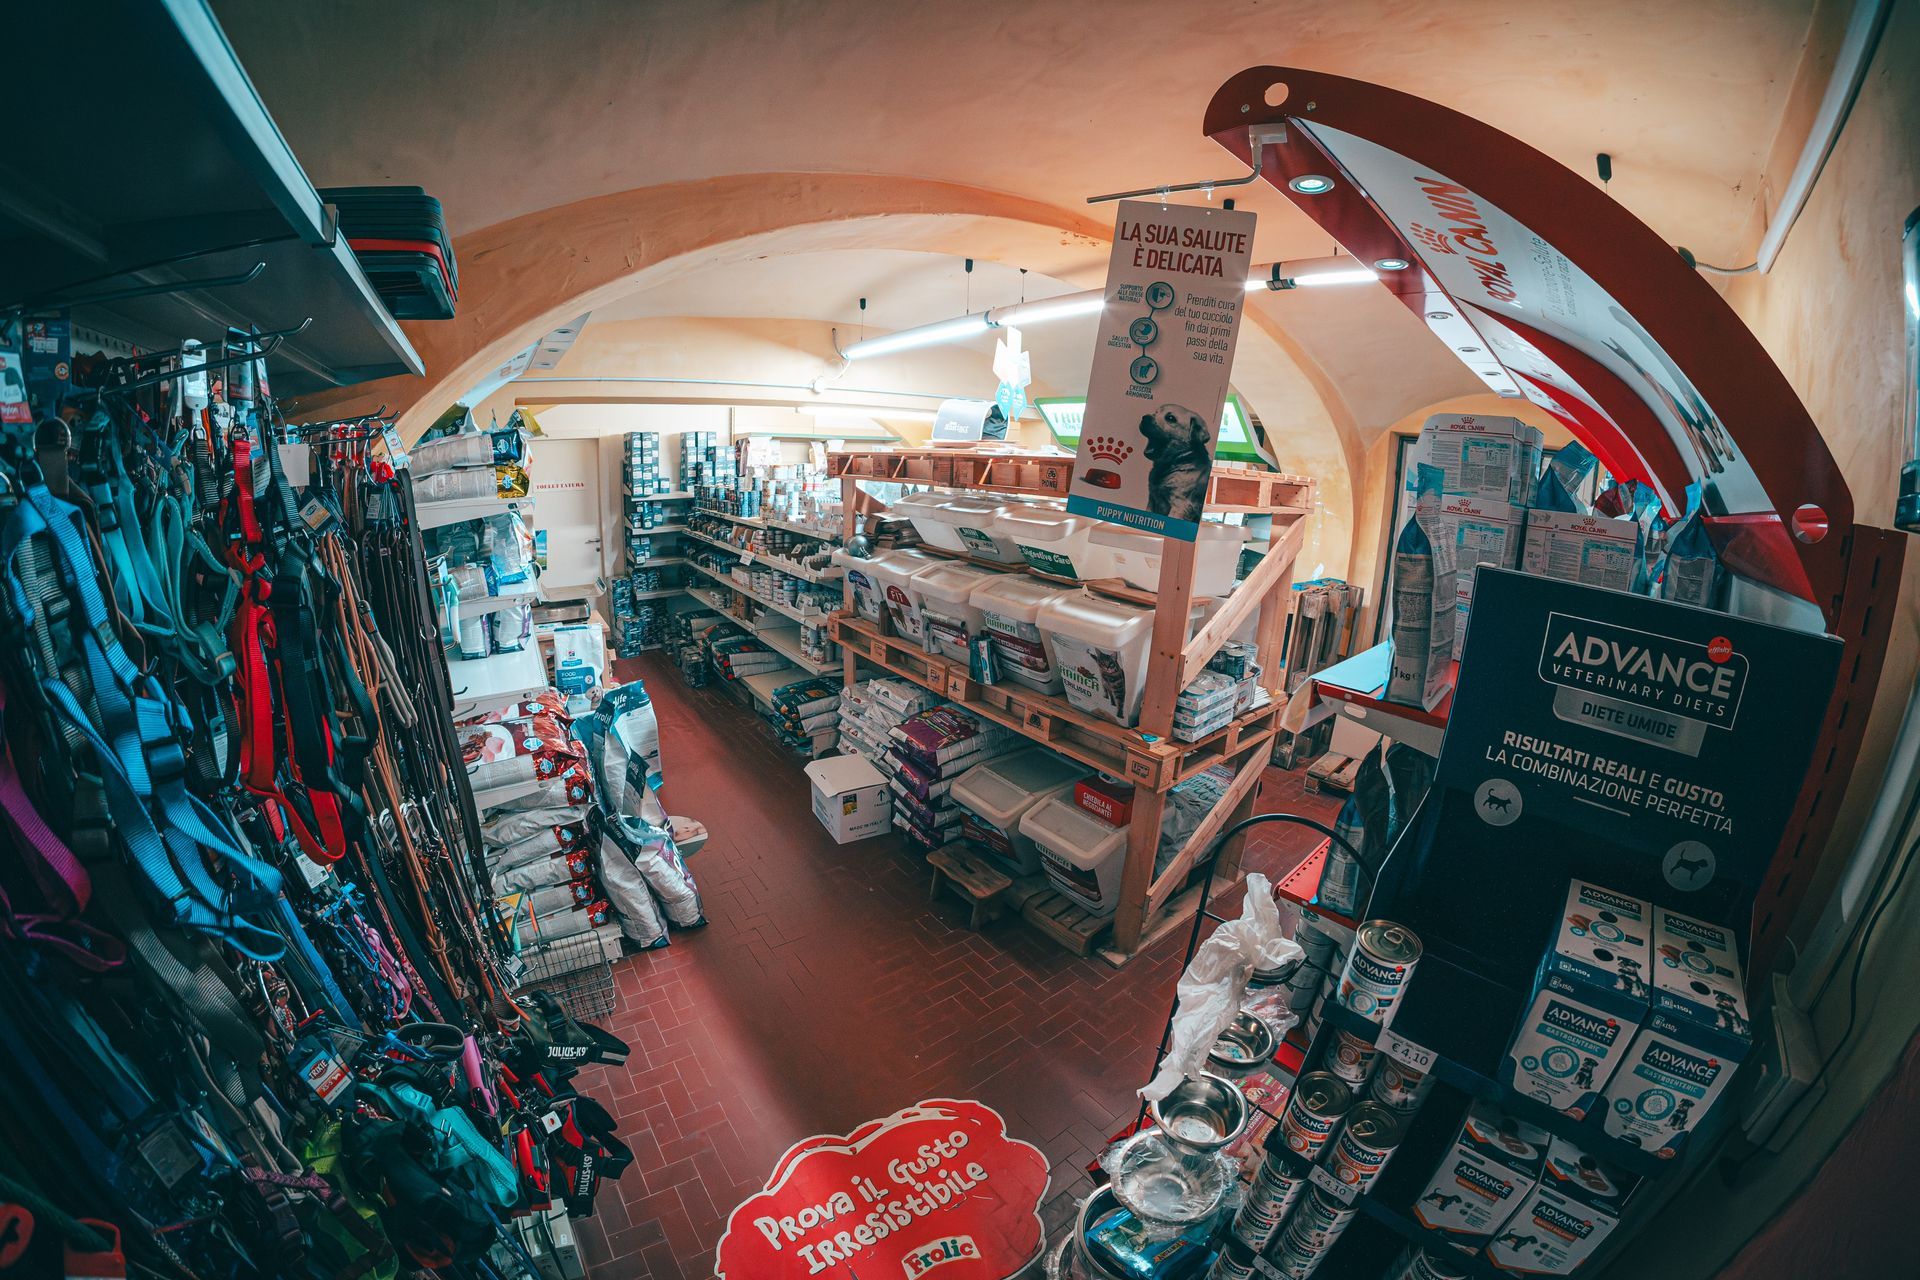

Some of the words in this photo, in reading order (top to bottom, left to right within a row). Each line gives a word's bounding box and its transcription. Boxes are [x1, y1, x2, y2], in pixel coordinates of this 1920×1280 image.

[1413, 176, 1499, 256] CANIN
[1120, 221, 1142, 243] LA
[1145, 223, 1180, 247] SUA
[1182, 227, 1247, 254] SALUTE
[1133, 243, 1145, 267] È
[1146, 248, 1224, 278] DELICATA
[1465, 256, 1517, 303] ROYAL
[1174, 305, 1187, 317] del
[1188, 307, 1200, 319] tuo
[1202, 311, 1233, 324] cucciolo
[1186, 293, 1217, 308] Prenditi
[1217, 300, 1236, 311] cura
[1184, 320, 1195, 332] fin
[1196, 322, 1209, 334] dai
[1210, 326, 1232, 338] primi
[1186, 336, 1208, 348] passi
[1208, 338, 1229, 351] della
[1192, 351, 1208, 361] sua
[1209, 352, 1225, 364] vita.
[1097, 505, 1123, 522] PUPPY
[1123, 510, 1165, 531] NUTRITION
[1446, 505, 1463, 513] ROYAL
[1464, 507, 1482, 515] CANIN
[1570, 523, 1588, 532] ROYAL
[1588, 526, 1608, 534] CANIN
[890, 589, 904, 603] FIT
[1553, 632, 1736, 699] ADVANCE
[1552, 663, 1664, 701] VETERINARY
[1673, 692, 1726, 717] DIETS
[1581, 701, 1623, 724] DIETE
[1627, 713, 1677, 739] UMIDE
[1503, 730, 1590, 768] RISULTATI
[1592, 756, 1647, 784] REALI
[1649, 772, 1661, 789] E
[1663, 777, 1726, 811] GUSTO,
[1485, 745, 1507, 765] LA
[1511, 753, 1643, 806] COMBINAZIONE
[1646, 794, 1733, 834] PERFETTA
[1583, 888, 1640, 910] ADVANCE
[1668, 918, 1723, 940] ADVANCE
[1354, 955, 1403, 980] ADVANCE
[1548, 1007, 1616, 1039] ADVANCE
[547, 1046, 587, 1058] JULIUS-K9
[1545, 1026, 1600, 1052] GASTROENTERIC
[1391, 1043, 1401, 1053] €
[1401, 1047, 1429, 1066] 4.10
[1648, 1047, 1717, 1080] ADVANCE
[308, 1059, 328, 1079] TRIXIE
[1643, 1068, 1699, 1094] GASTROENTERIC
[1292, 1104, 1331, 1130] ADVANCE
[1343, 1137, 1384, 1162] ADVANCE
[578, 1153, 593, 1196] JULIUS-K9
[1324, 1180, 1346, 1195] 4.10
[1459, 1164, 1513, 1195] ADVANCE
[1538, 1205, 1592, 1235] ADVANCE
[901, 1237, 975, 1278] Frolic
